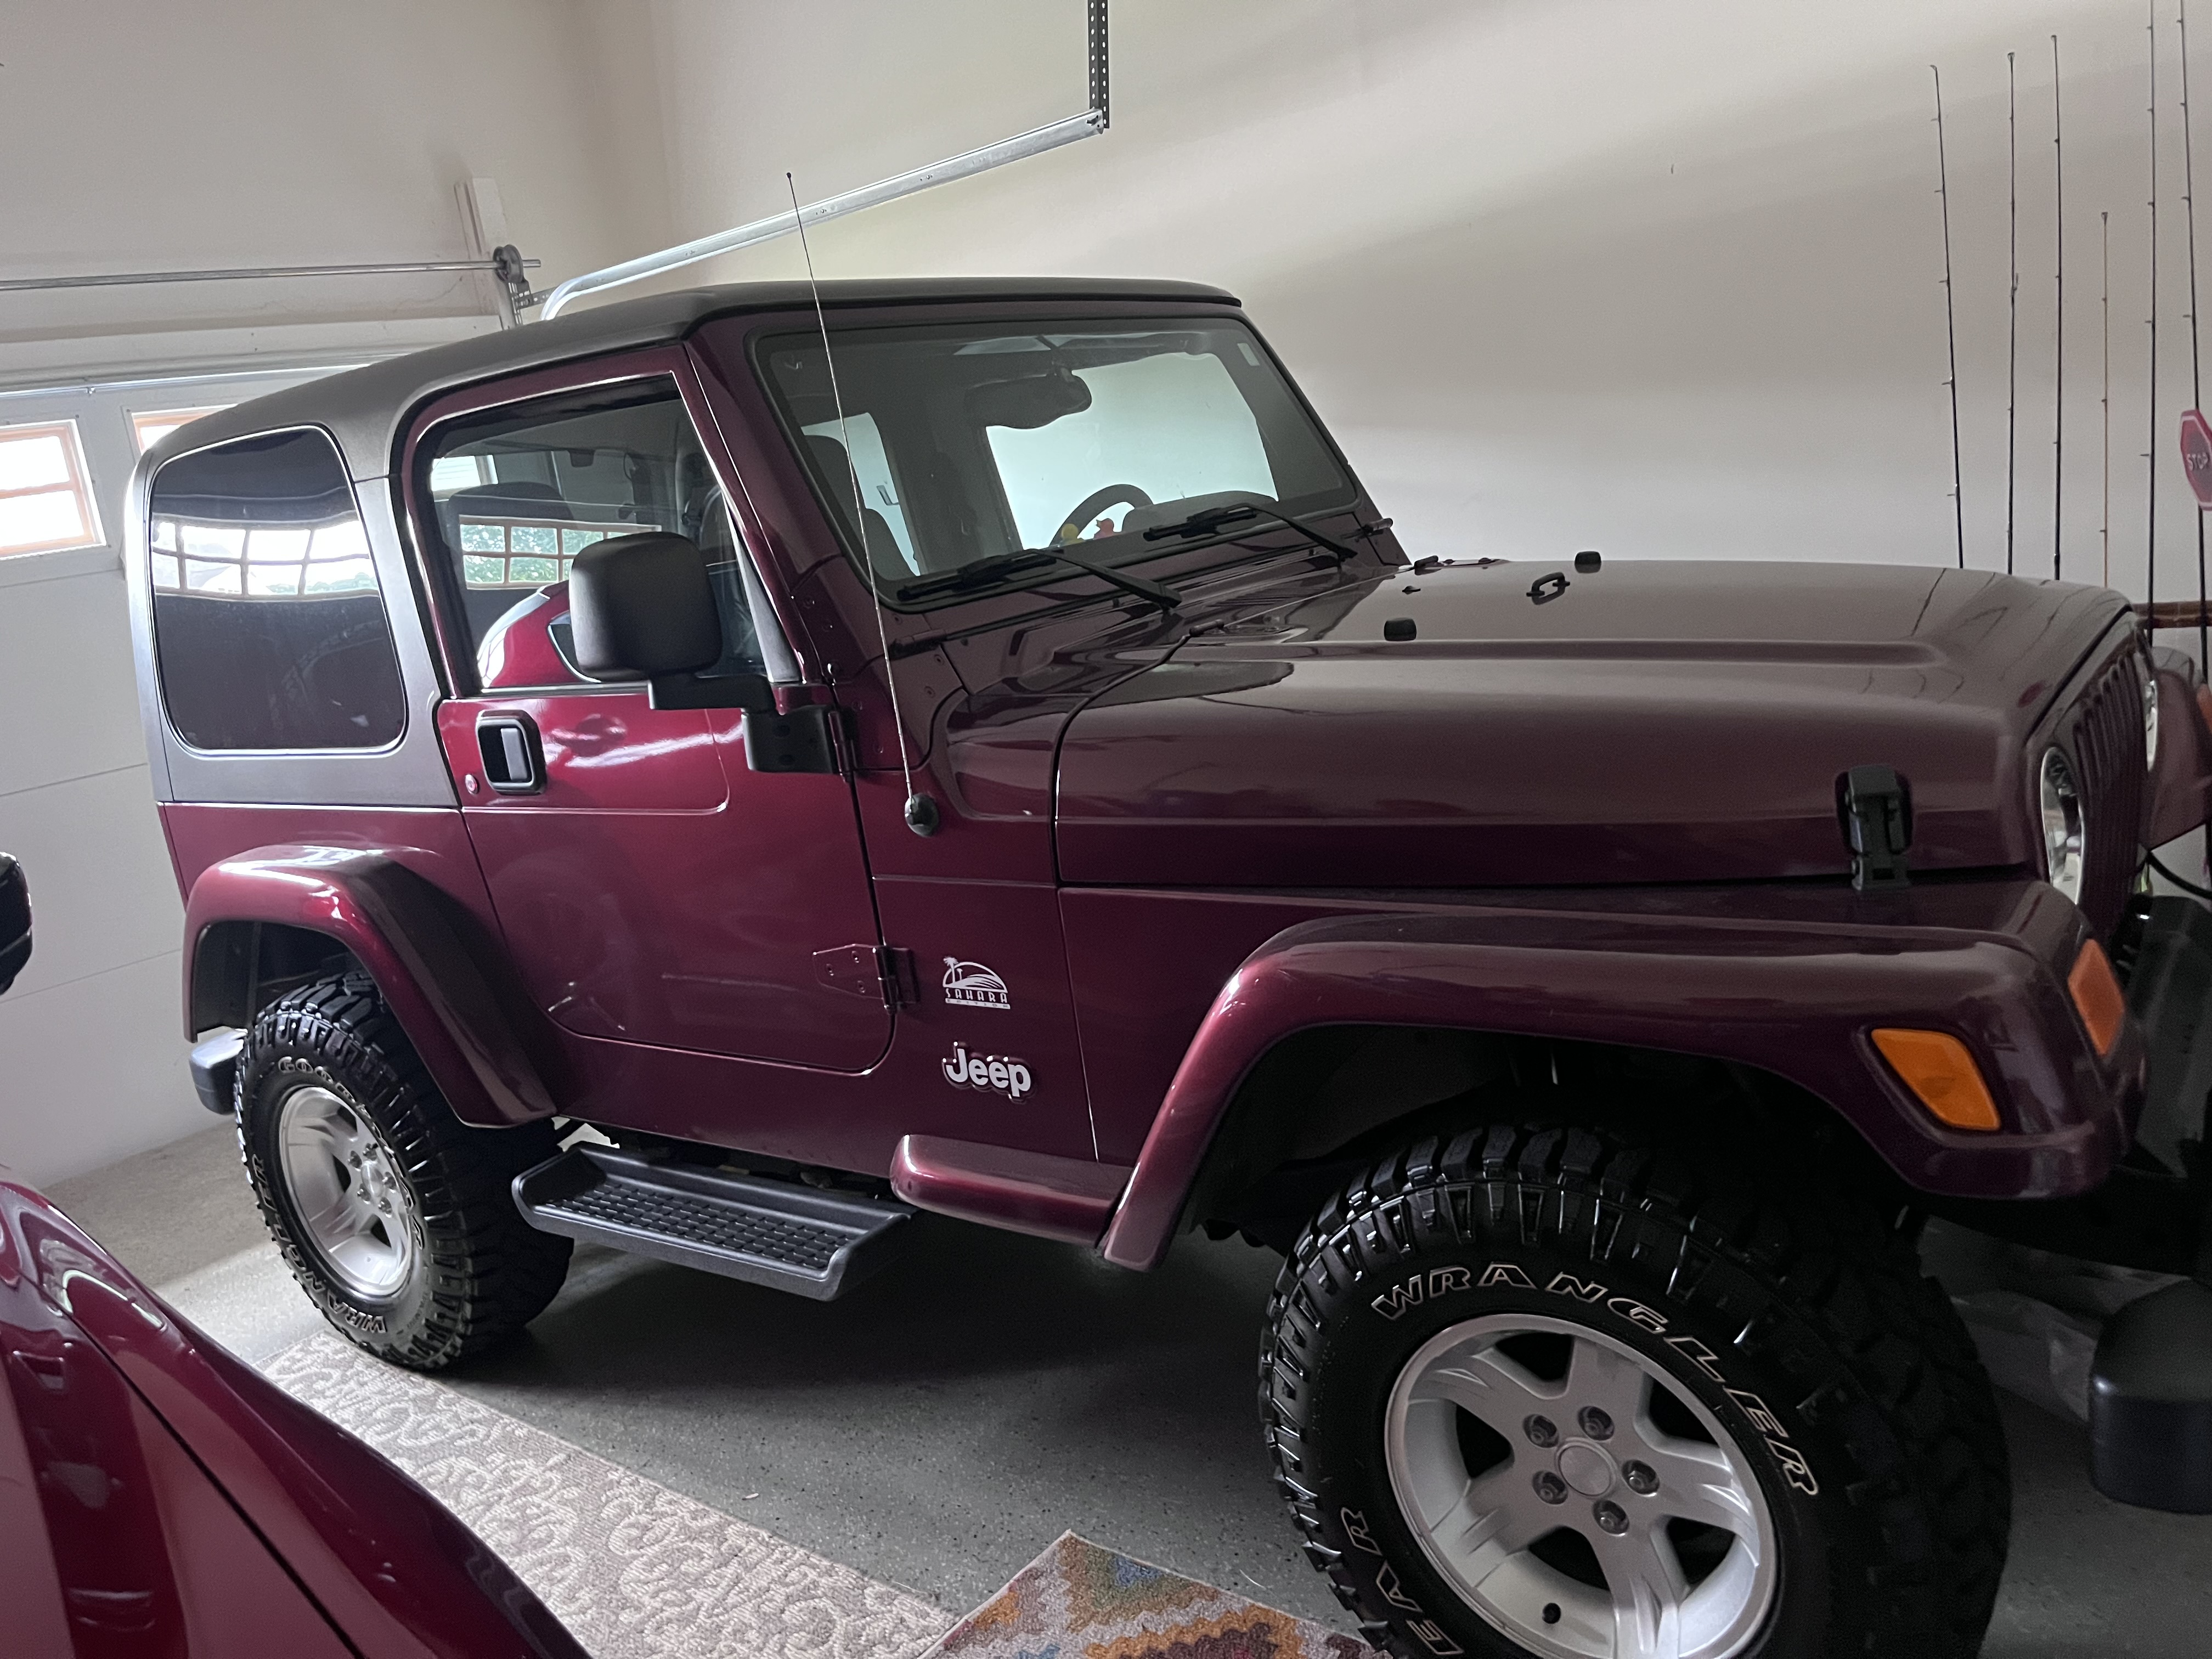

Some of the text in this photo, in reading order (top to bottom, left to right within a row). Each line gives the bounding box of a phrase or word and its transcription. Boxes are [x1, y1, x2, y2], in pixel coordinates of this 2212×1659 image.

[946, 988, 1007, 1003] SAHARA
[945, 1048, 1031, 1098] Jeep
[1372, 1263, 1818, 1496] WRANGLER
[1340, 1507, 1465, 1655] EAR
